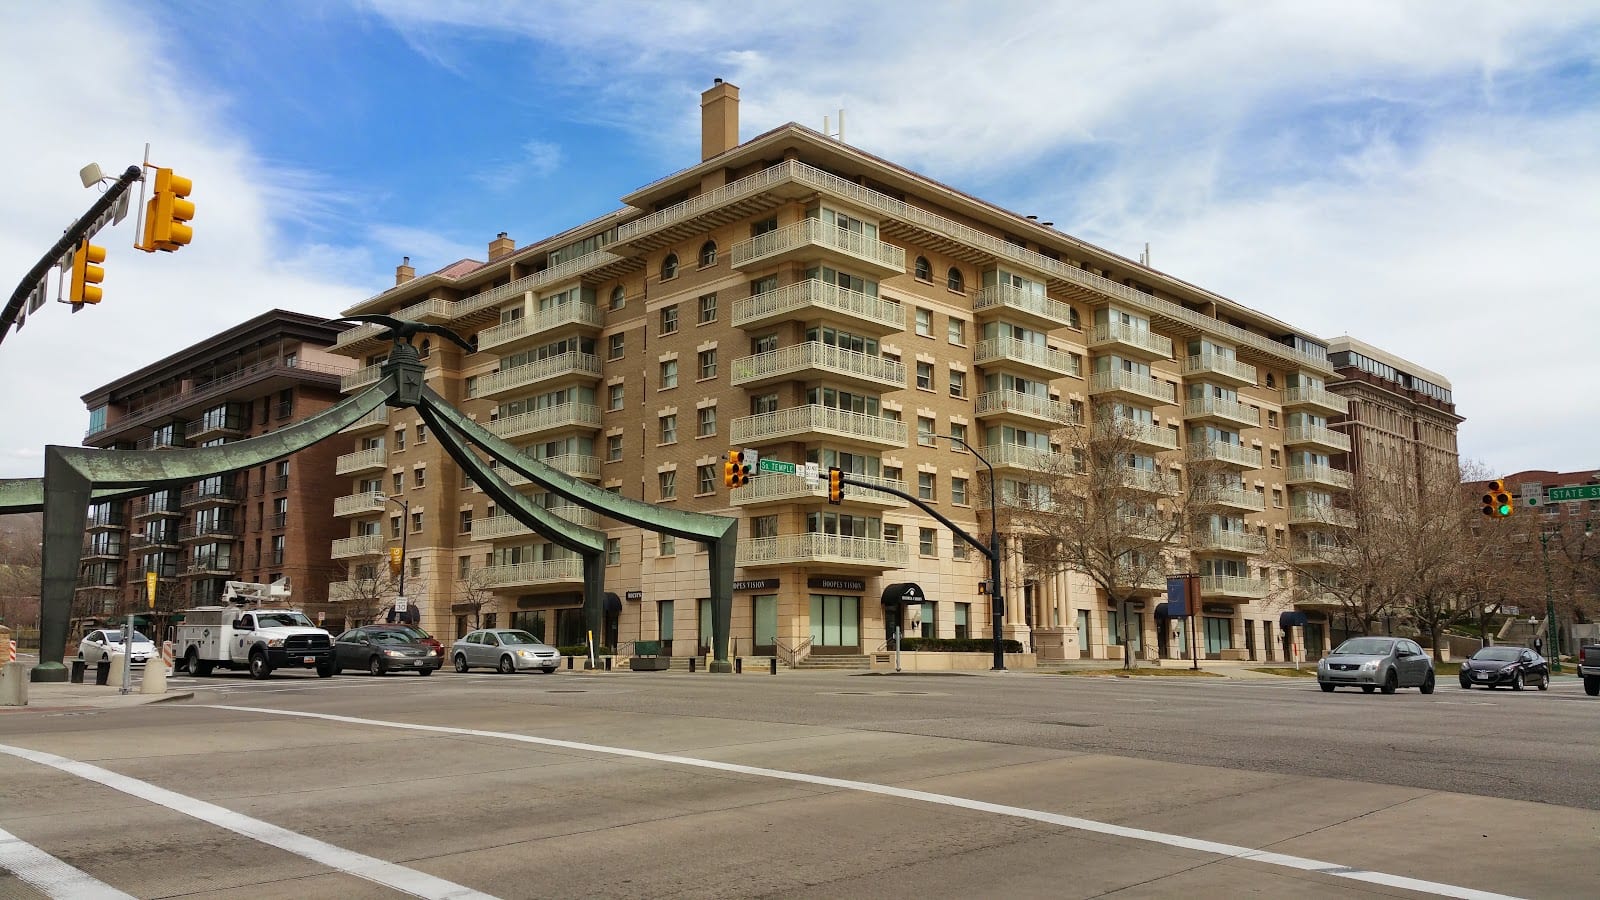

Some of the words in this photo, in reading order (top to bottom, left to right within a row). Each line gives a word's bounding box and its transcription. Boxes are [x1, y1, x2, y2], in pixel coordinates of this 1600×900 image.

[771, 463, 794, 473] TEMPLE
[1553, 489, 1584, 499] STATE
[746, 581, 765, 589] VISION
[822, 580, 843, 588] HOOPES
[844, 581, 862, 590] VISION
